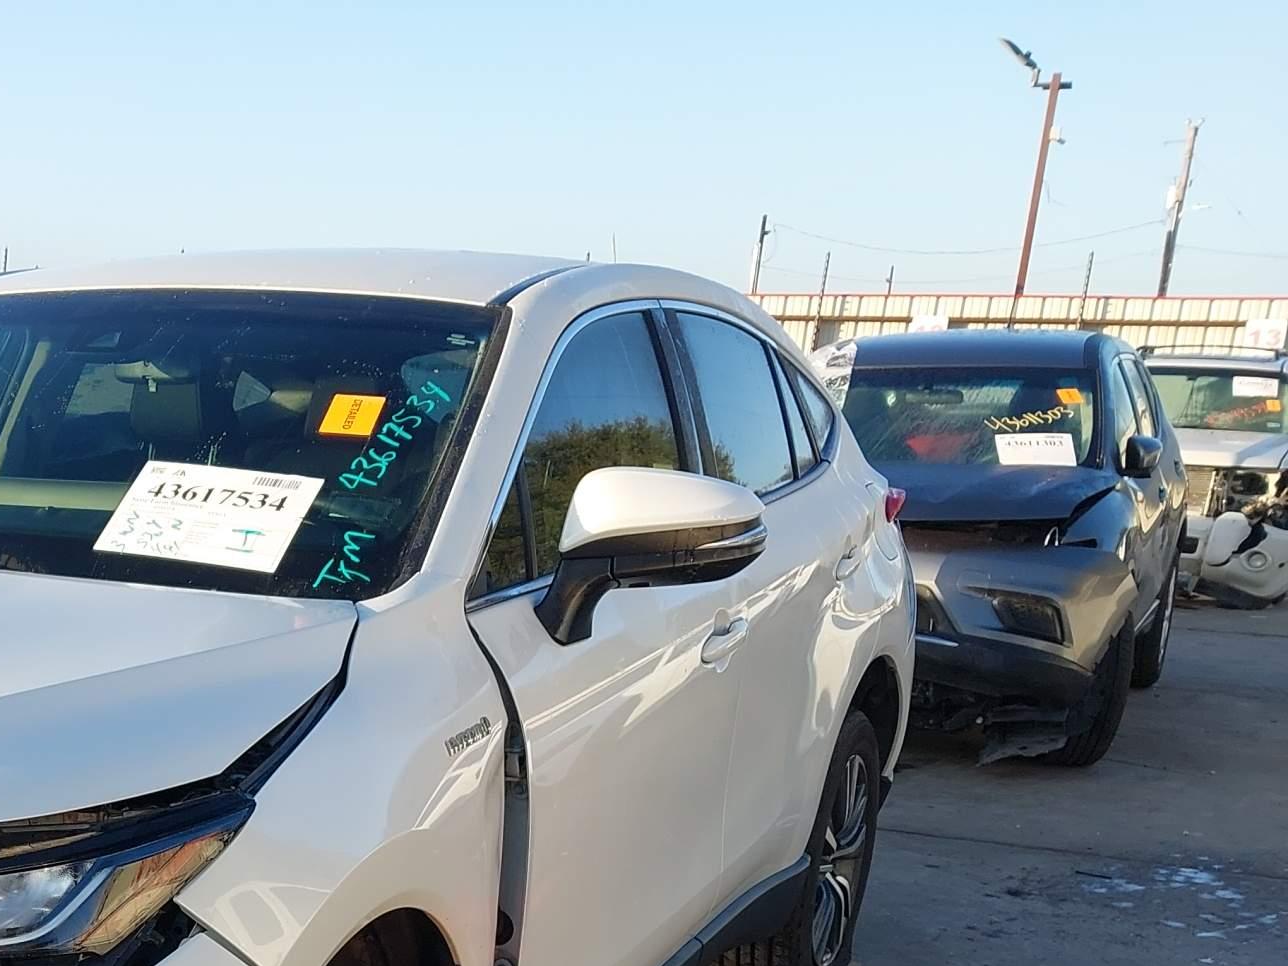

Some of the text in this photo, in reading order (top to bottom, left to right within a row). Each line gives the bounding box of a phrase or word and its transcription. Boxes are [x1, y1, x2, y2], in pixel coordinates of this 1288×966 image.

[983, 405, 1075, 433] 43611303
[339, 380, 451, 490] 43617534
[148, 481, 290, 512] 43617534
